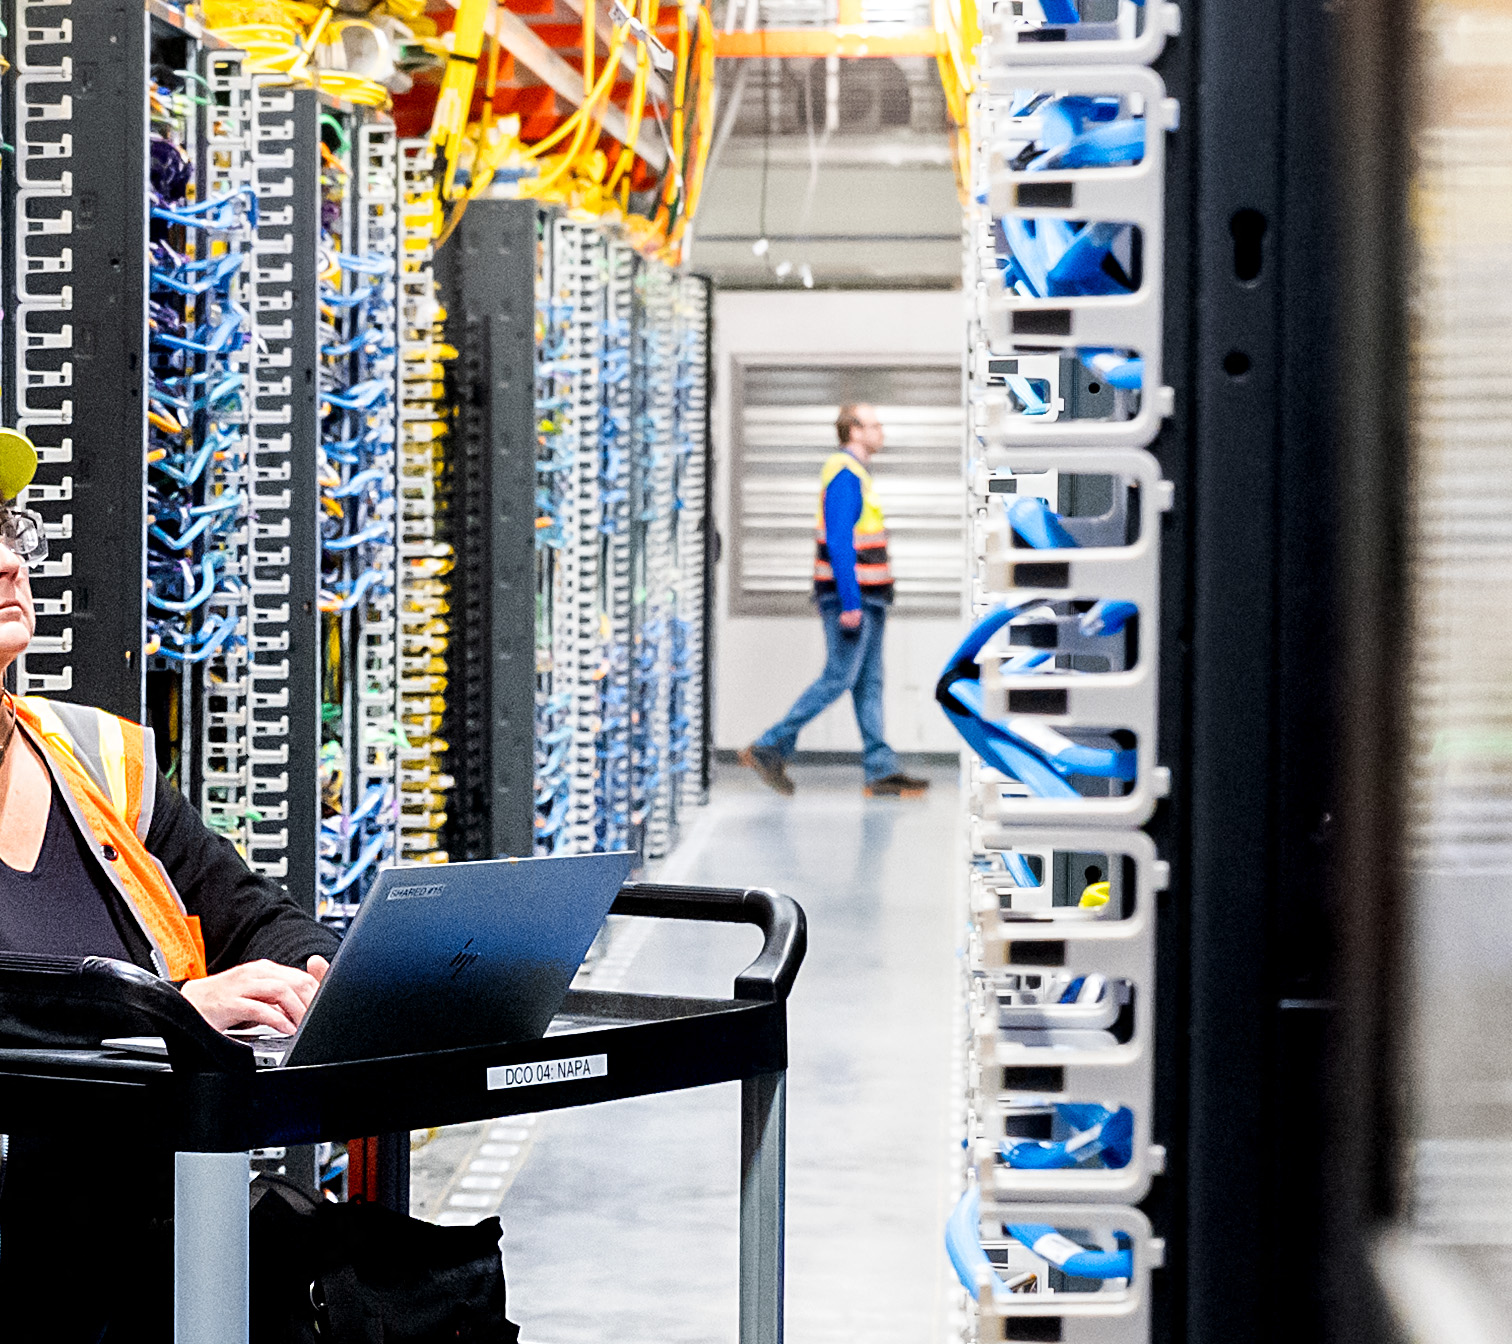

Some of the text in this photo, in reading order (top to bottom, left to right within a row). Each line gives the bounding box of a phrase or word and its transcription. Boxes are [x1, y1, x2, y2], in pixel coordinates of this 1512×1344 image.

[390, 887, 426, 898] SHARED
[505, 1058, 591, 1086] DCO 04: NAPA
